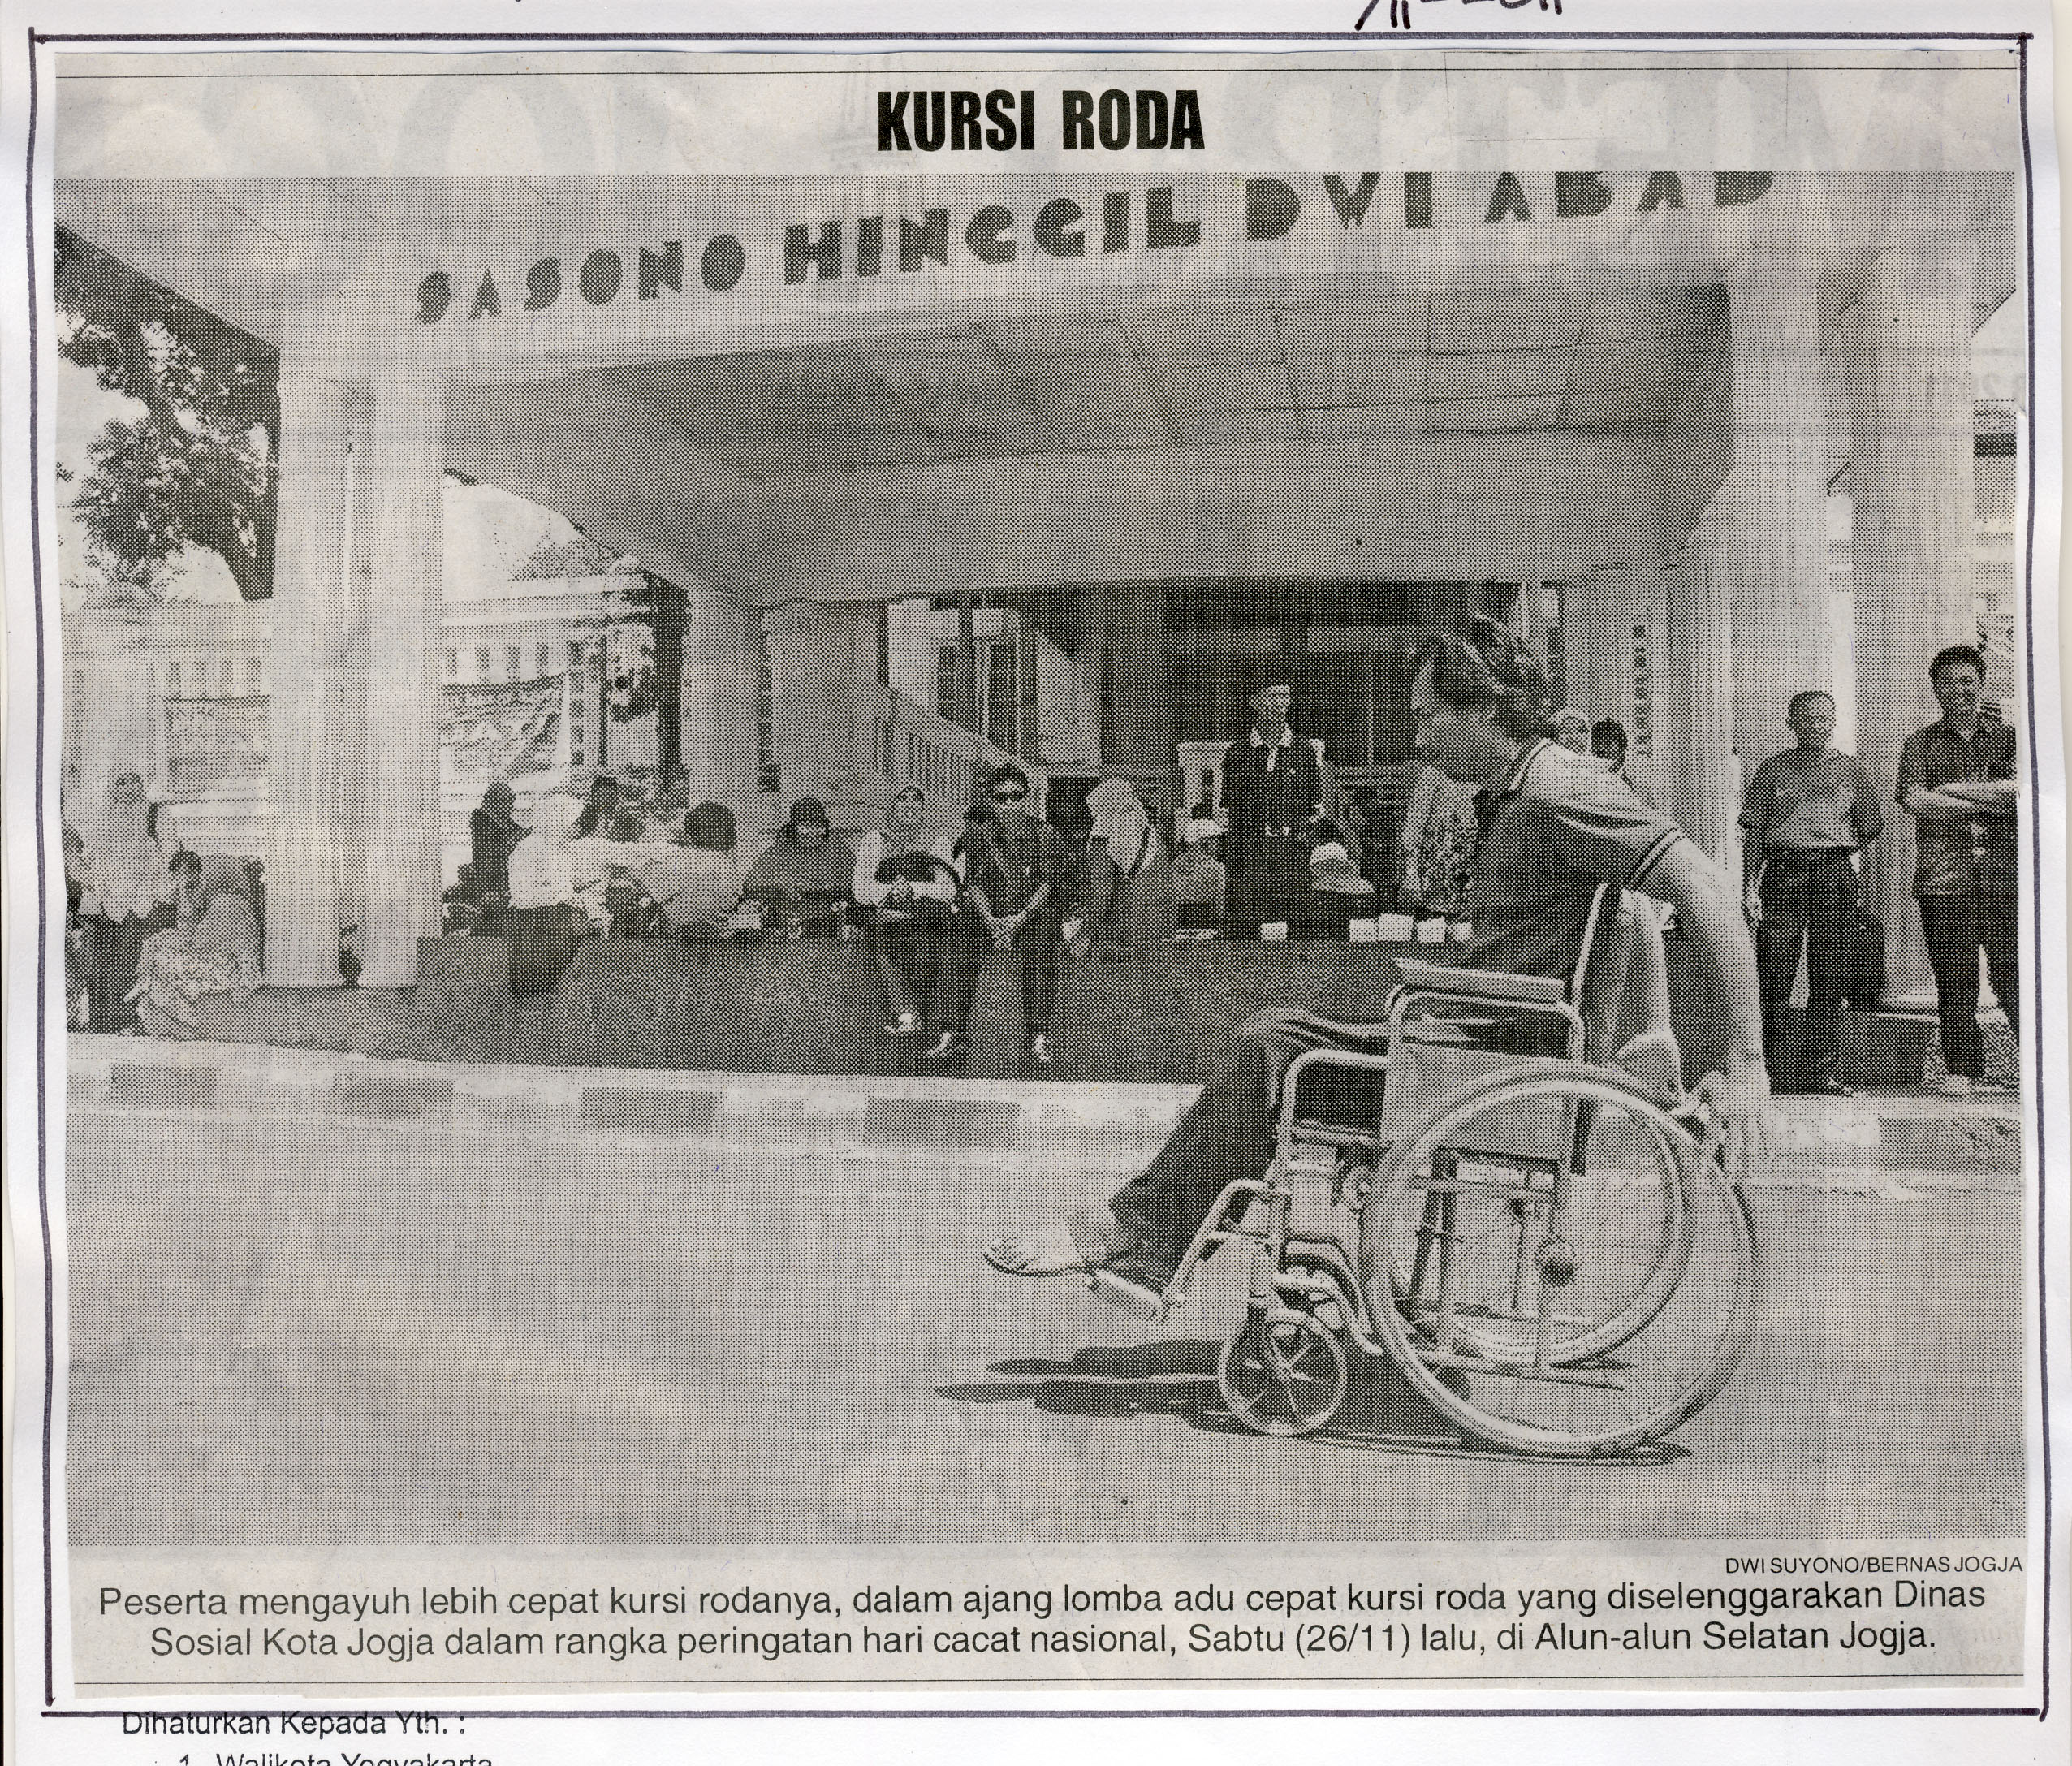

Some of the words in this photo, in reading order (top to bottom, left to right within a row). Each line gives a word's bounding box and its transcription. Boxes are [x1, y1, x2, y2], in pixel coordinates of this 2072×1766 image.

[878, 89, 1035, 152] KURSI
[1062, 89, 1206, 151] RODA
[416, 233, 745, 324] SASONO
[783, 186, 1200, 284] HINGGIL
[1245, 171, 1432, 240] DWI
[1484, 171, 1773, 224] ABAD
[1725, 1557, 1765, 1574] DWI
[1771, 1556, 1950, 1574] SUYONO/BERNAS
[1954, 1556, 2023, 1573] JOGJA
[100, 1587, 227, 1616] Peserta
[240, 1587, 410, 1622] mengayuh
[422, 1587, 497, 1615] lebih
[508, 1588, 599, 1621] cepat
[611, 1586, 685, 1614] kursi
[699, 1586, 840, 1621] rodanya,
[853, 1585, 952, 1613] dalam
[963, 1584, 1051, 1620] ajang
[1064, 1583, 1163, 1612] lomba
[1174, 1583, 1234, 1612] adu
[1246, 1585, 1337, 1618] cepat
[1348, 1582, 1422, 1611] kursi
[1436, 1582, 1507, 1611] roda
[1517, 1589, 1596, 1617] yang
[1607, 1580, 1882, 1617] diselenggarakan
[1895, 1579, 1985, 1608] Dinas
[151, 1627, 251, 1656] Sosial
[264, 1627, 338, 1656] Kota
[347, 1628, 434, 1663] Jogja
[445, 1627, 543, 1655] dalam
[555, 1626, 667, 1662] rangka
[678, 1626, 852, 1661] peringatan
[863, 1625, 922, 1653] hari
[933, 1626, 1021, 1653] cacat
[1031, 1624, 1176, 1657] nasional,
[1189, 1623, 1284, 1652] Sabtu
[1296, 1622, 1410, 1659] (26/11)
[1422, 1623, 1485, 1656] lalu,
[1497, 1622, 1524, 1651] di
[1535, 1622, 1691, 1651] Alun-alun
[1703, 1621, 1828, 1650] Selatan
[1840, 1620, 1936, 1656] Jogja.
[123, 1711, 270, 1734] Dihaturkan
[281, 1710, 386, 1740] Kepada
[395, 1710, 447, 1734] Yth.
